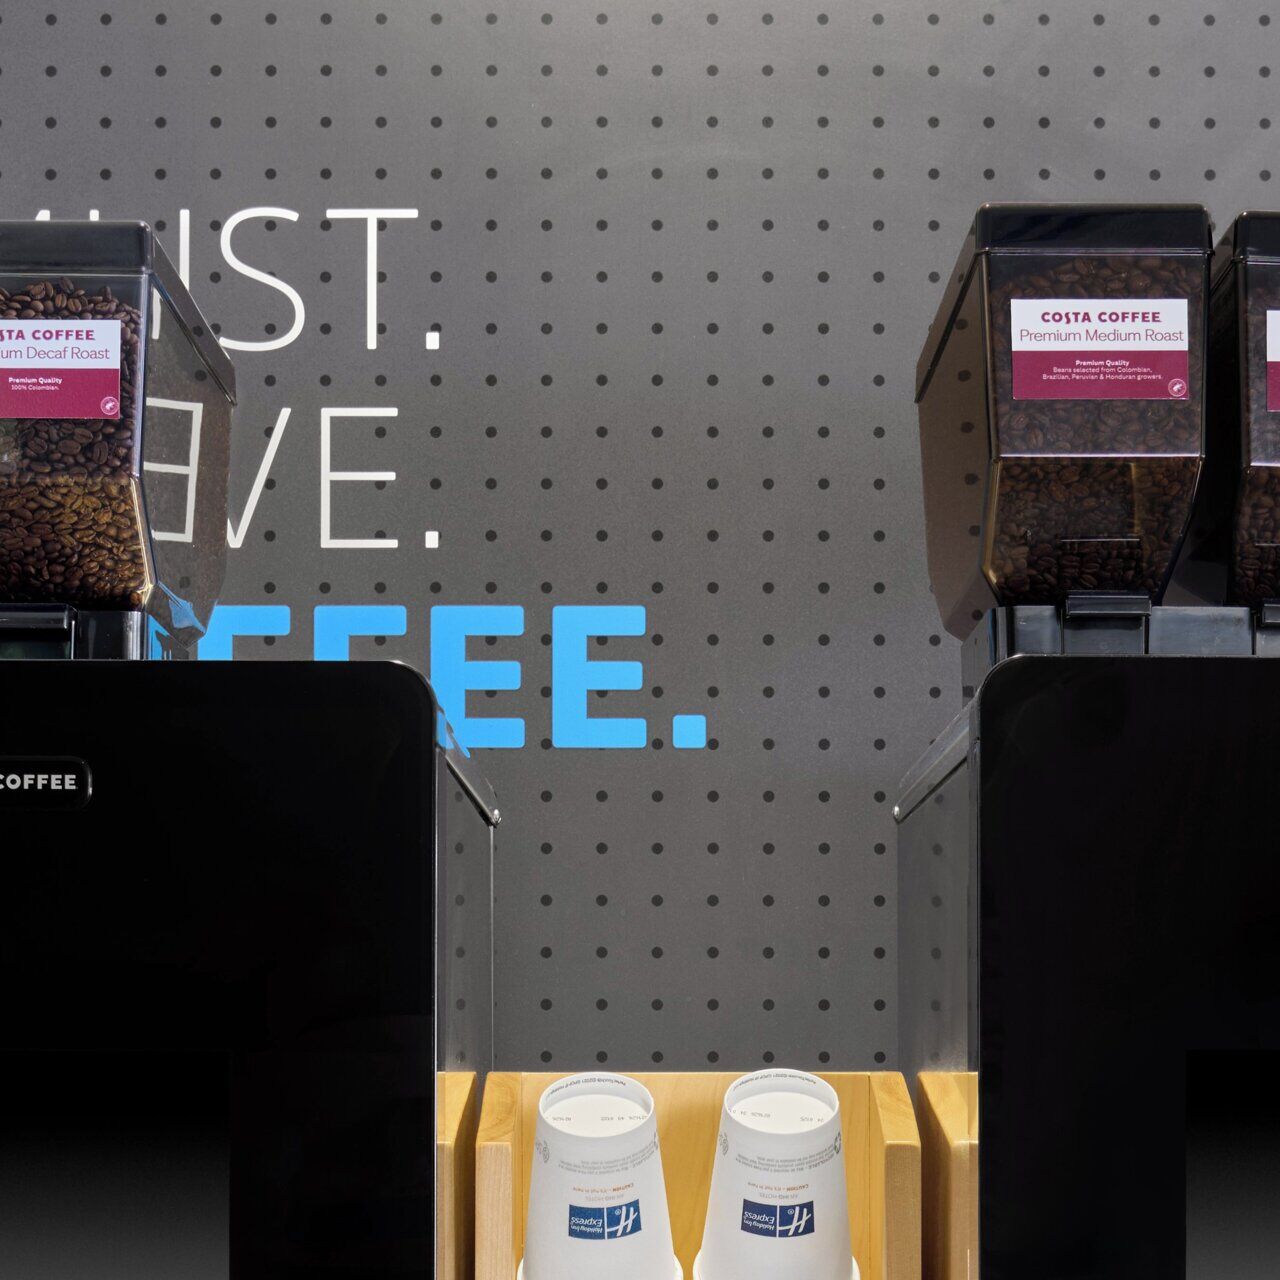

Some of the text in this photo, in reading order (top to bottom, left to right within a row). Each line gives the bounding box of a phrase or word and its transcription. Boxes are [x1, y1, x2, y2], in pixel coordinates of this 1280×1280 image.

[1041, 312, 1161, 324] COSTA COFFEE
[32, 330, 95, 340] COFFEE
[1020, 329, 1183, 341] Premium Medium Roast
[27, 347, 68, 359] Decaf
[71, 347, 109, 359] Roast
[571, 1217, 602, 1226] Express
[745, 1211, 775, 1224] Express
[744, 1219, 774, 1230] Holiday Inn
